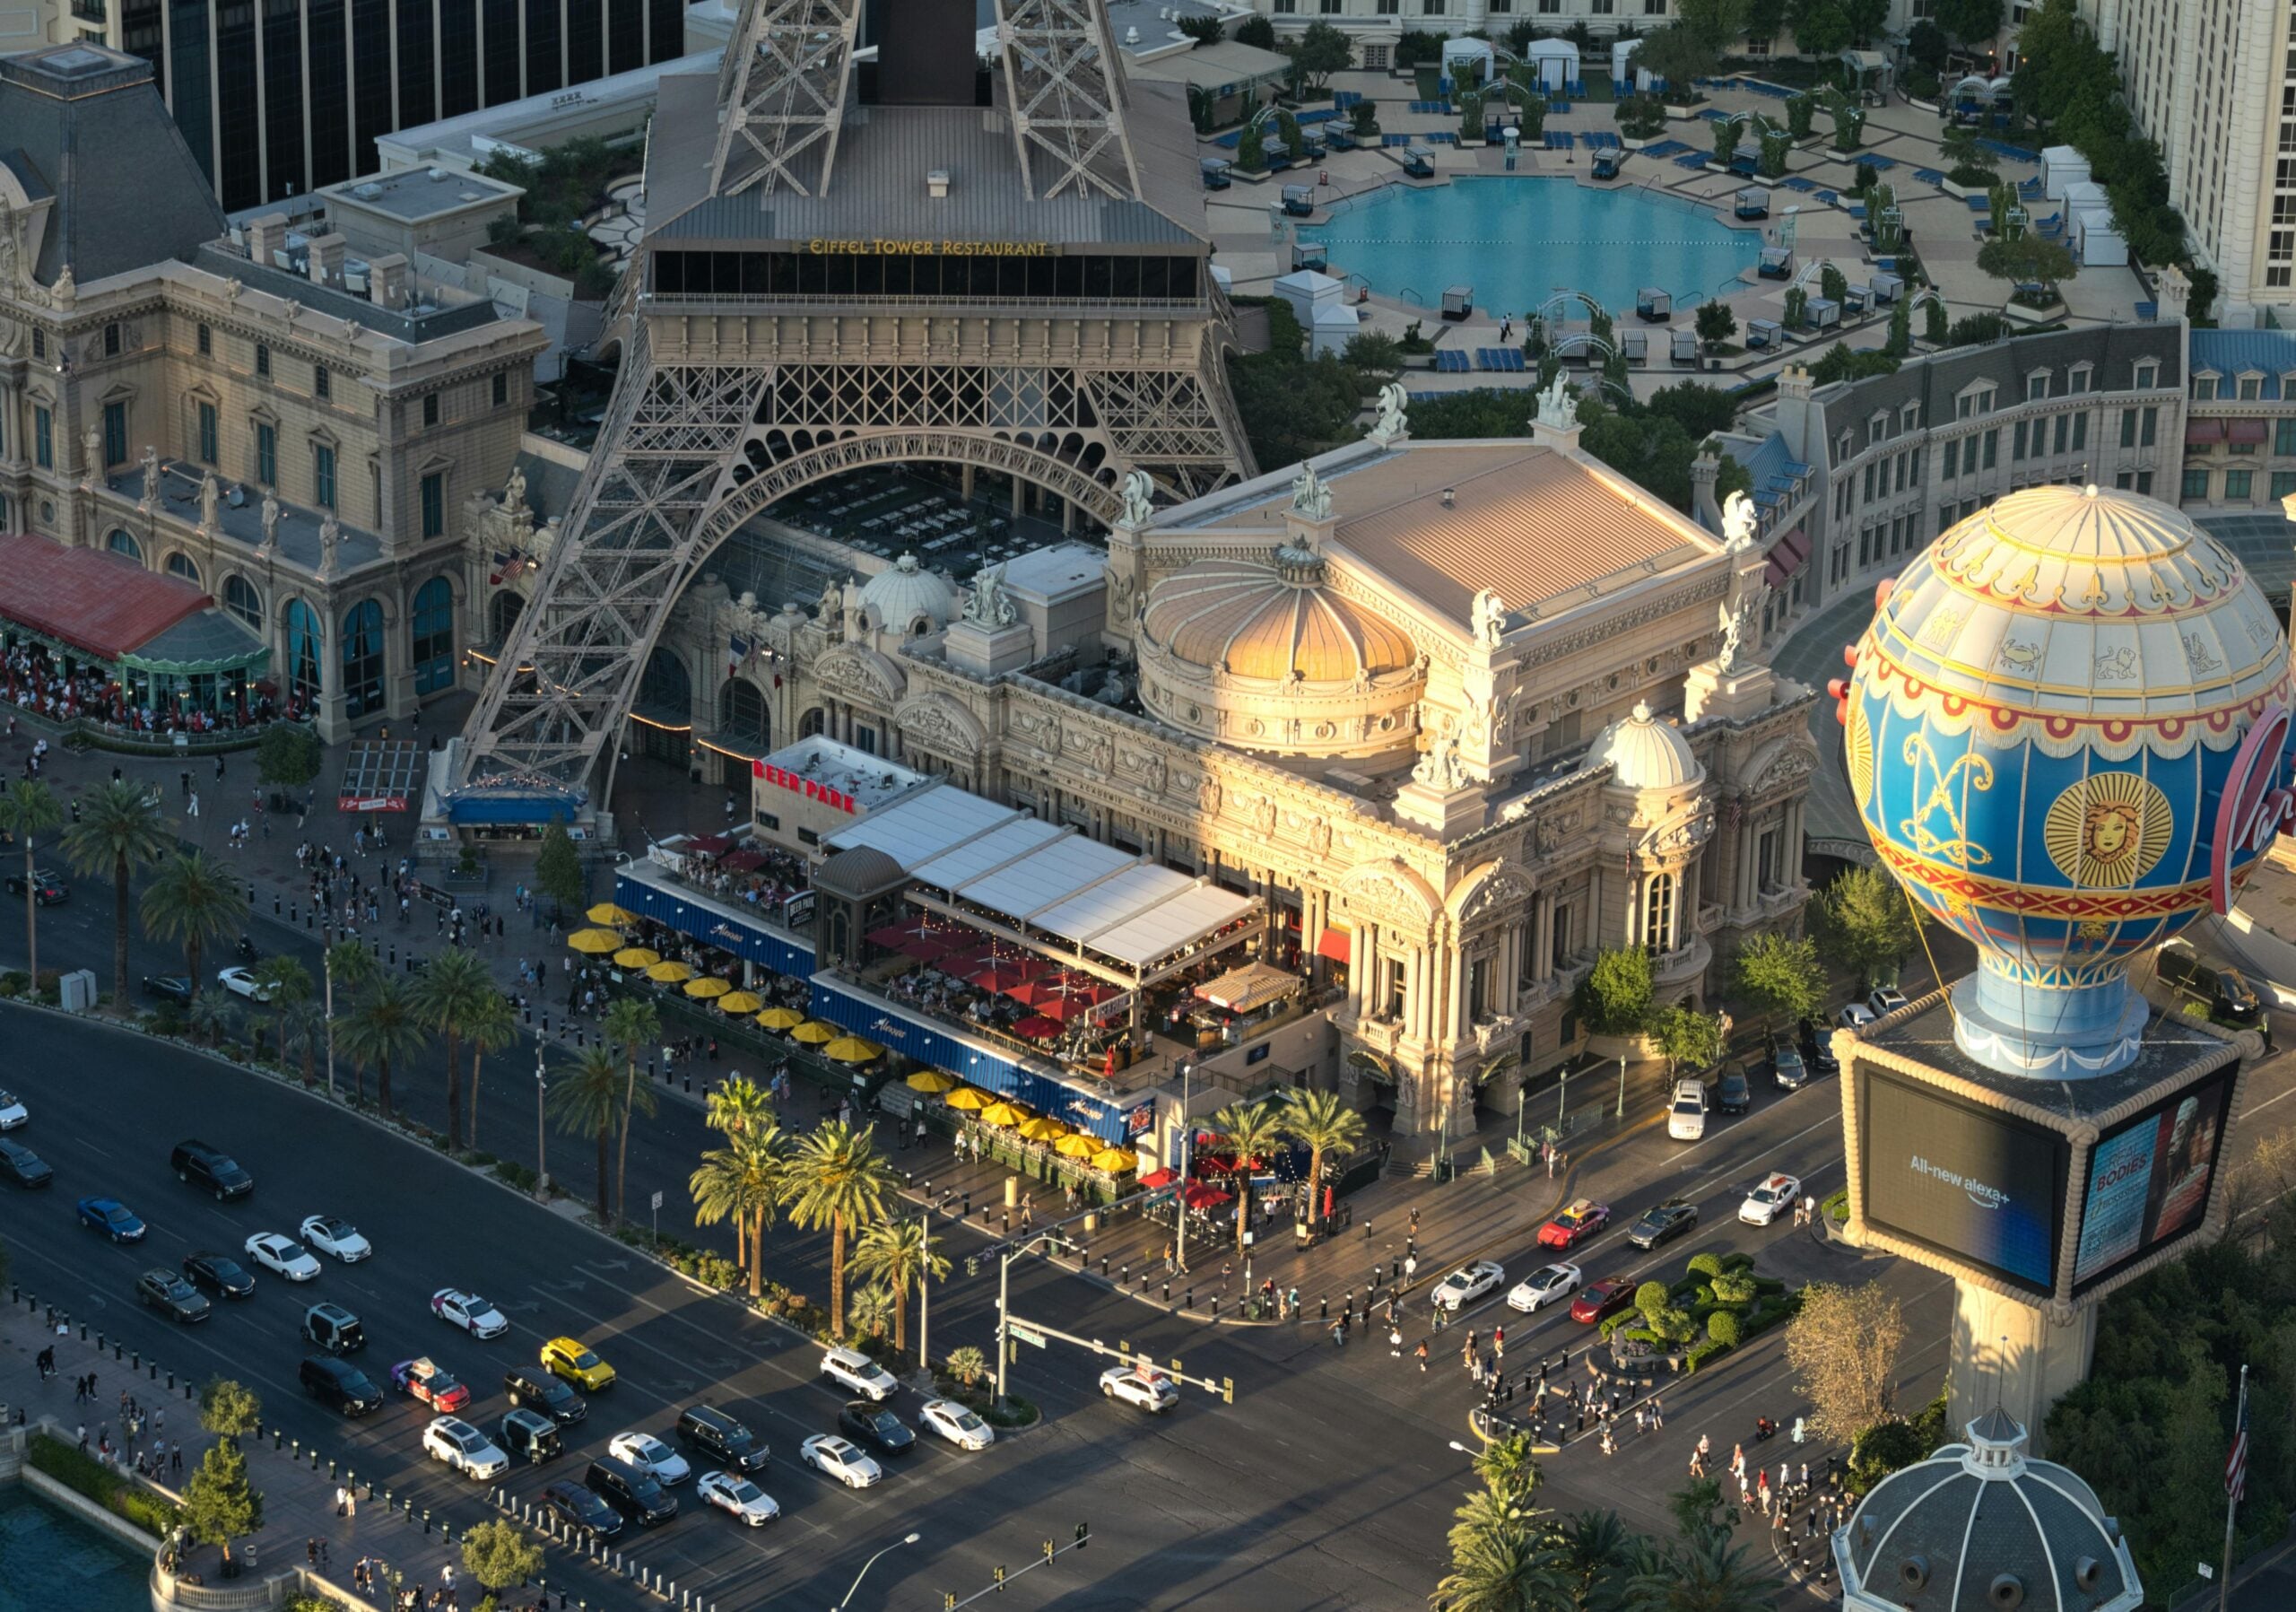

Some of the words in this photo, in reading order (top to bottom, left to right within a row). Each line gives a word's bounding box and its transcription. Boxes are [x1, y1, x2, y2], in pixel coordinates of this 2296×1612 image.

[810, 240, 868, 255] EIFFEL
[873, 240, 934, 255] TOWER
[944, 241, 1048, 256] RESTAURANT
[753, 759, 800, 794] BEER
[805, 780, 857, 815] PARK
[790, 900, 803, 917] BEER
[803, 896, 815, 911] PARK
[2109, 1142, 2138, 1165] REAL
[1910, 1155, 1962, 1187] All-new
[1964, 1178, 2010, 1204] alexa+
[2097, 1153, 2148, 1192] BODIES
